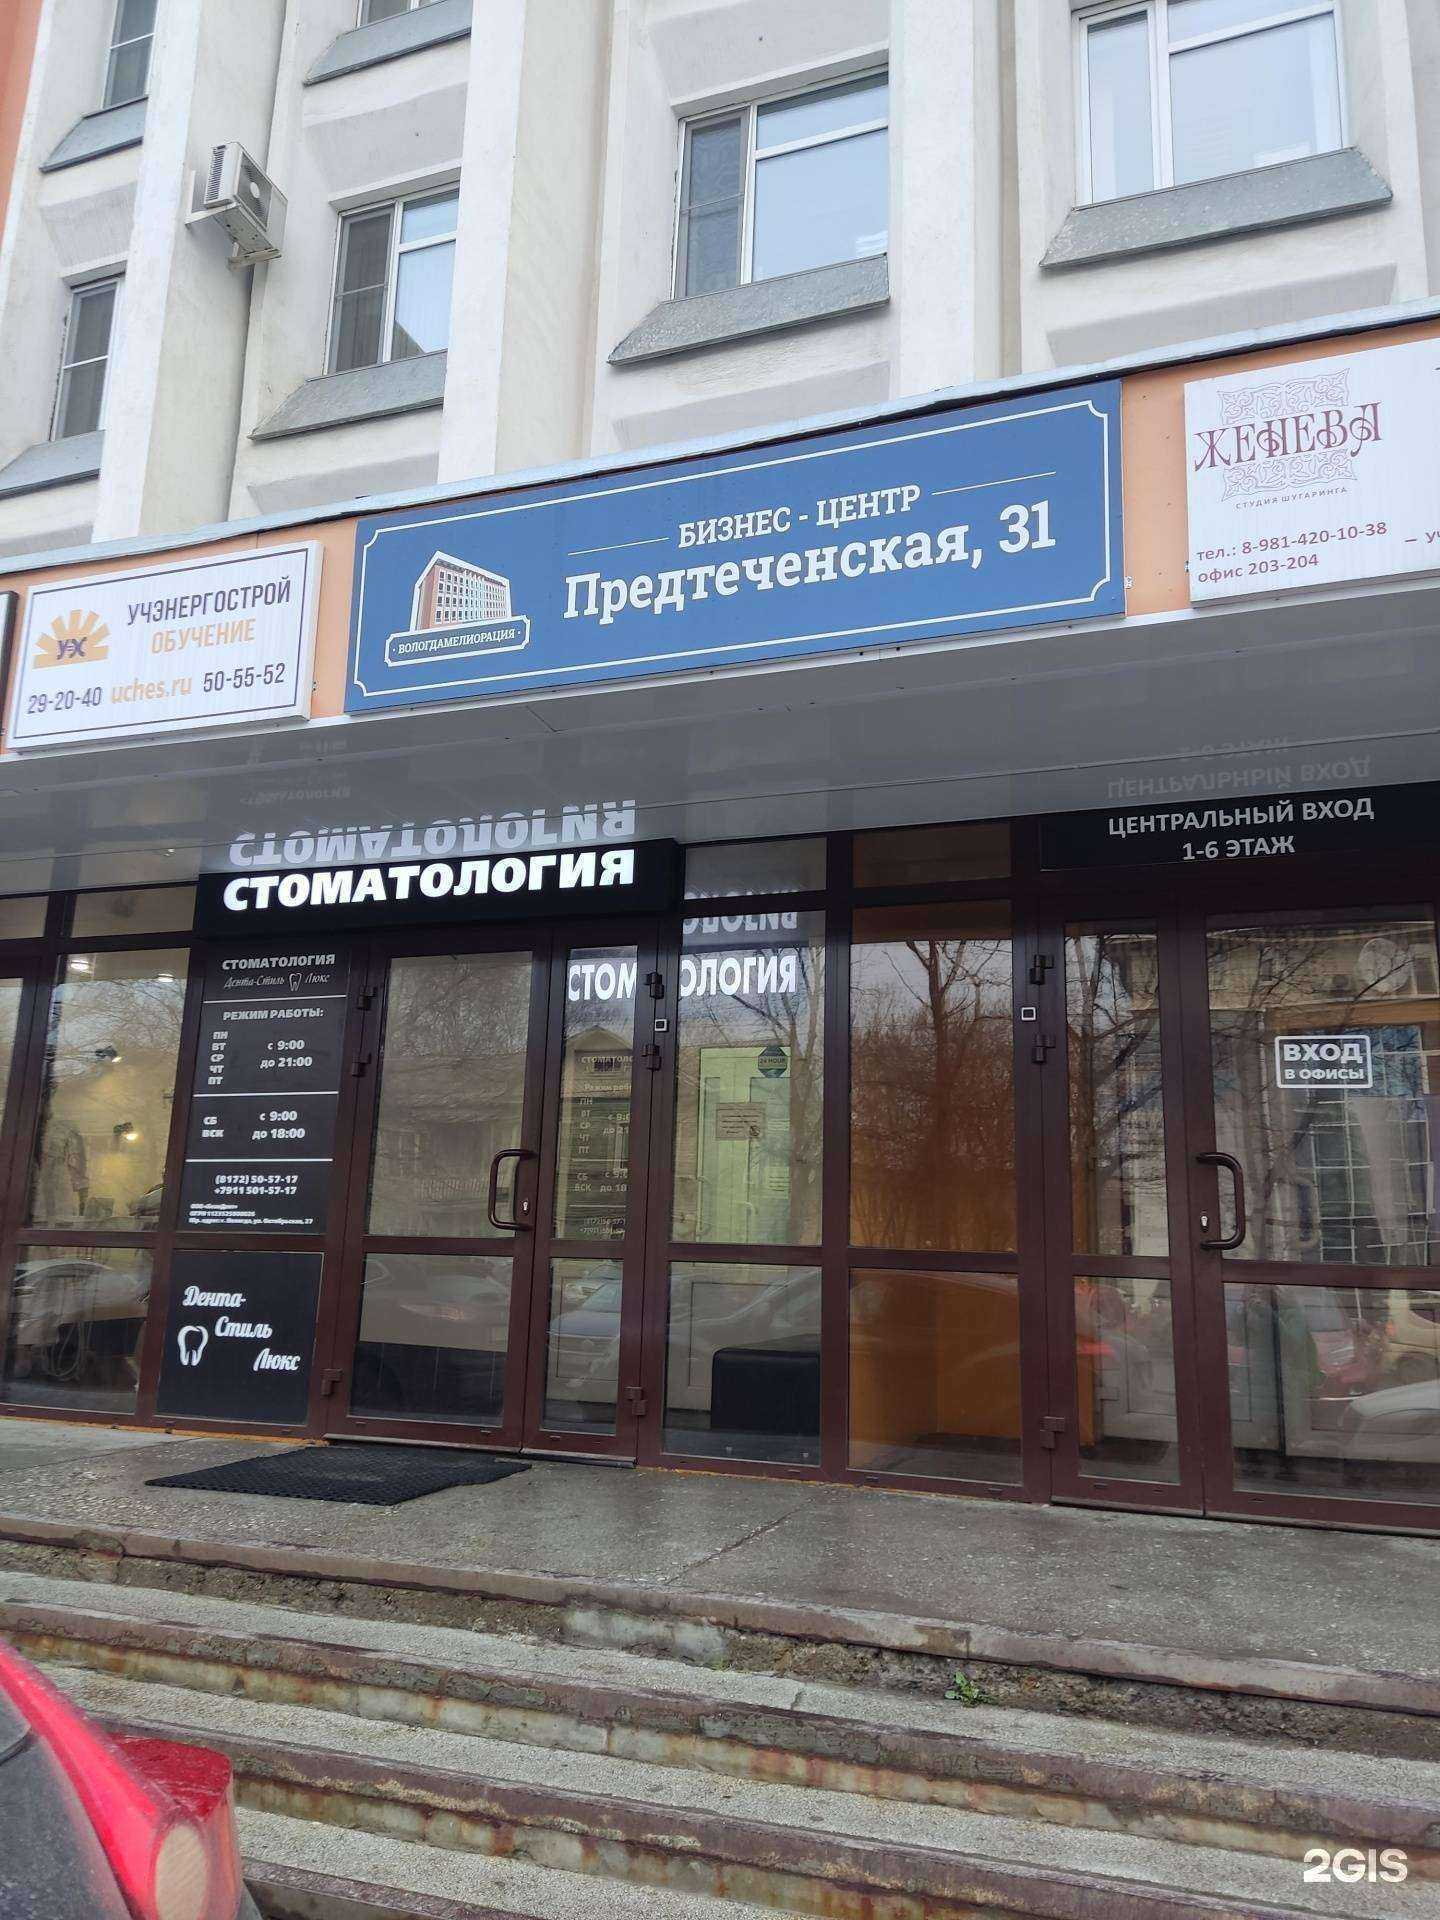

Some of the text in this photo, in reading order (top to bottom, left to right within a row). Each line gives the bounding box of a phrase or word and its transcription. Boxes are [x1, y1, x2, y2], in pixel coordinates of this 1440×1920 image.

[1235, 486, 1348, 510] СТУДИЯ ШУГАРИНГА
[678, 506, 791, 549] БИЗНЕС
[816, 484, 921, 528] ЦЕНТР
[1197, 521, 1387, 561] тел.: 8-981-420-10-38
[564, 499, 1056, 625] Предтеченская, 31
[1198, 553, 1319, 584] офис 203-204
[127, 576, 291, 626] УЧЭНЕРГОСТРОЙ
[151, 618, 256, 654] ОБУЧЕНИЕ
[398, 628, 516, 655] ВОЛОГДАМЕЛИОРАЦИЯ
[27, 662, 286, 715] 29-20-40 uches.ru 50-55-52
[1108, 797, 1375, 838] ЦЕНТРАЛЬНЫЙ ВХОД
[1182, 835, 1296, 861] 1-6 ЭТАЖ
[223, 850, 635, 911] СТОМАТОЛОГИЯ
[222, 954, 335, 970] СТОМАТОЛОГИЯ
[305, 972, 330, 984] Люкс
[223, 1007, 324, 1021] РЕЖИМ РАБОТЫ:
[213, 1031, 228, 1040] ПН
[212, 1042, 226, 1051] ВТ
[277, 1040, 305, 1050] 9:00
[210, 1054, 225, 1062] СР
[1283, 1044, 1363, 1064] ВХОД
[210, 1065, 224, 1073] ЧТ
[260, 1056, 313, 1069] до 21:00
[208, 1076, 223, 1085] ПТ
[1285, 1068, 1364, 1080] В ОФИСЫ
[203, 1116, 218, 1125] СБ
[269, 1111, 298, 1121] 9:00
[202, 1129, 224, 1138] ВСК
[252, 1128, 306, 1140] до 18:00
[215, 1174, 298, 1186] (8172) 50-57-17
[214, 1185, 297, 1195] +7911 501-57-17
[182, 1285, 246, 1308] Дента-
[214, 1316, 273, 1339] Стиль
[253, 1347, 300, 1372] Люкс
